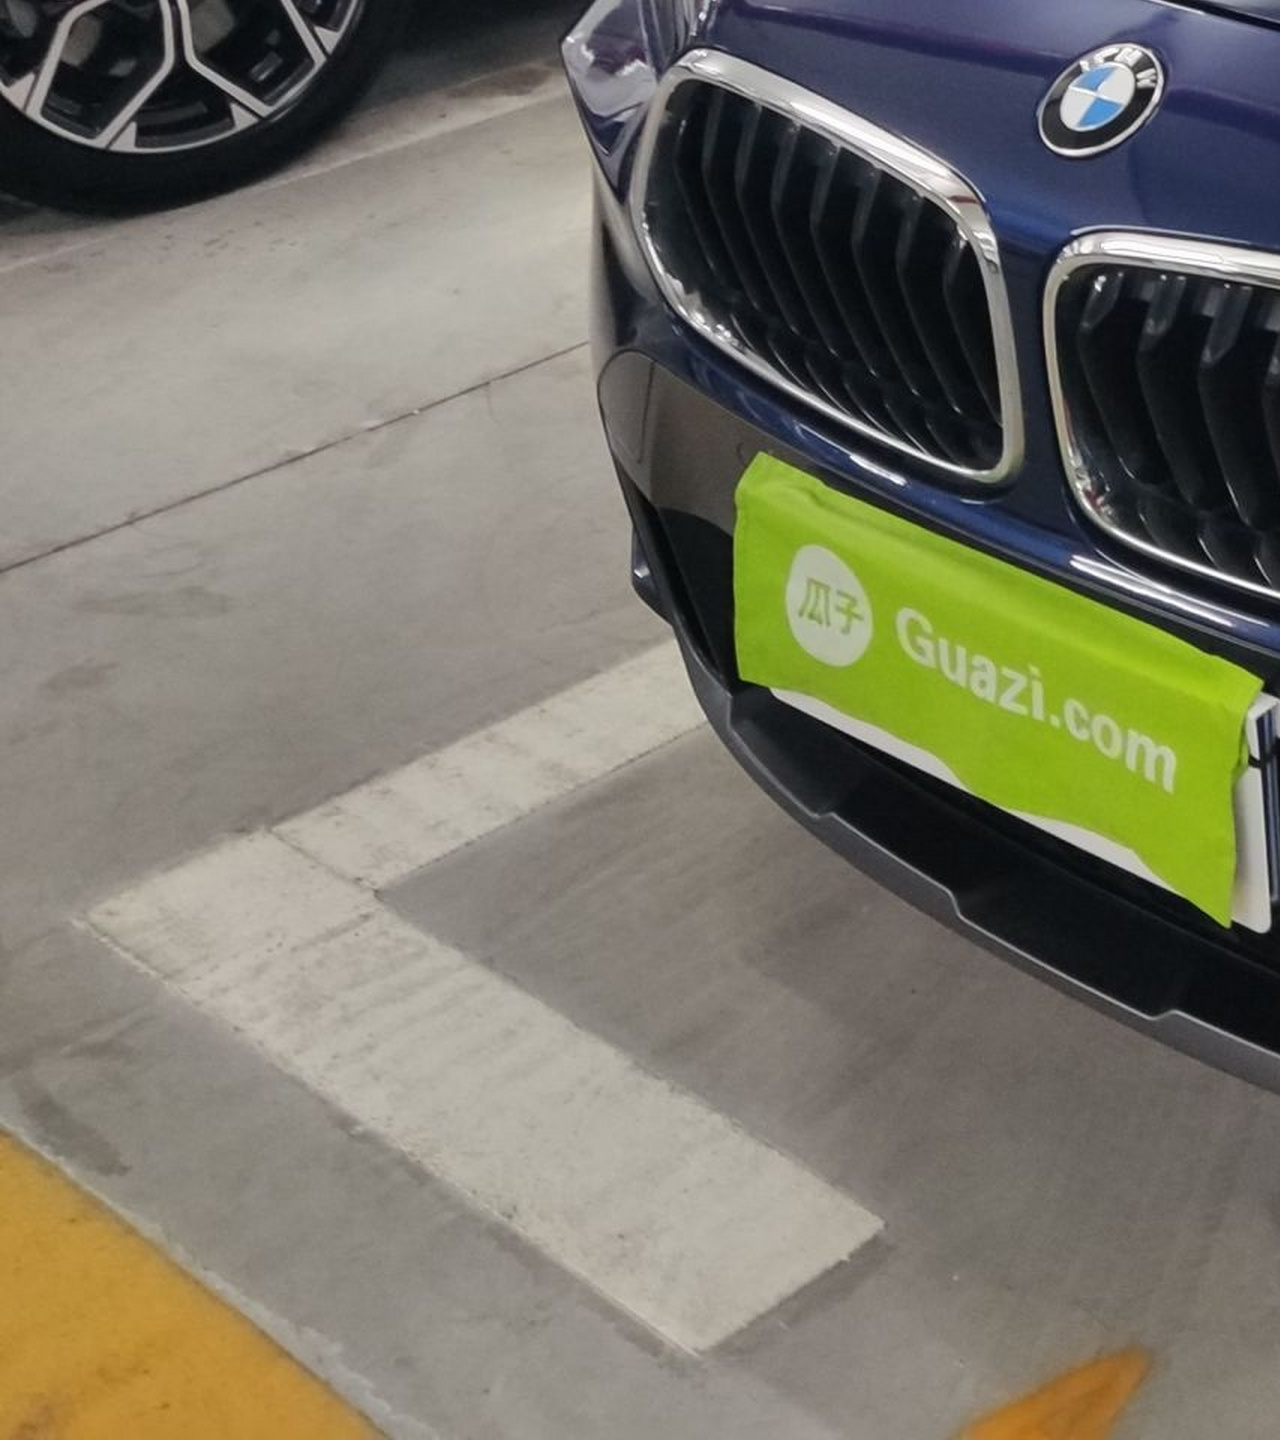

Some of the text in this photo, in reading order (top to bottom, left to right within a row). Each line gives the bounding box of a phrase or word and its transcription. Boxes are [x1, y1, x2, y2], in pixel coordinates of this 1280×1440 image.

[1079, 47, 1157, 89] BMW
[798, 577, 865, 636] 瓜子
[895, 606, 1178, 794] Guazi.com
